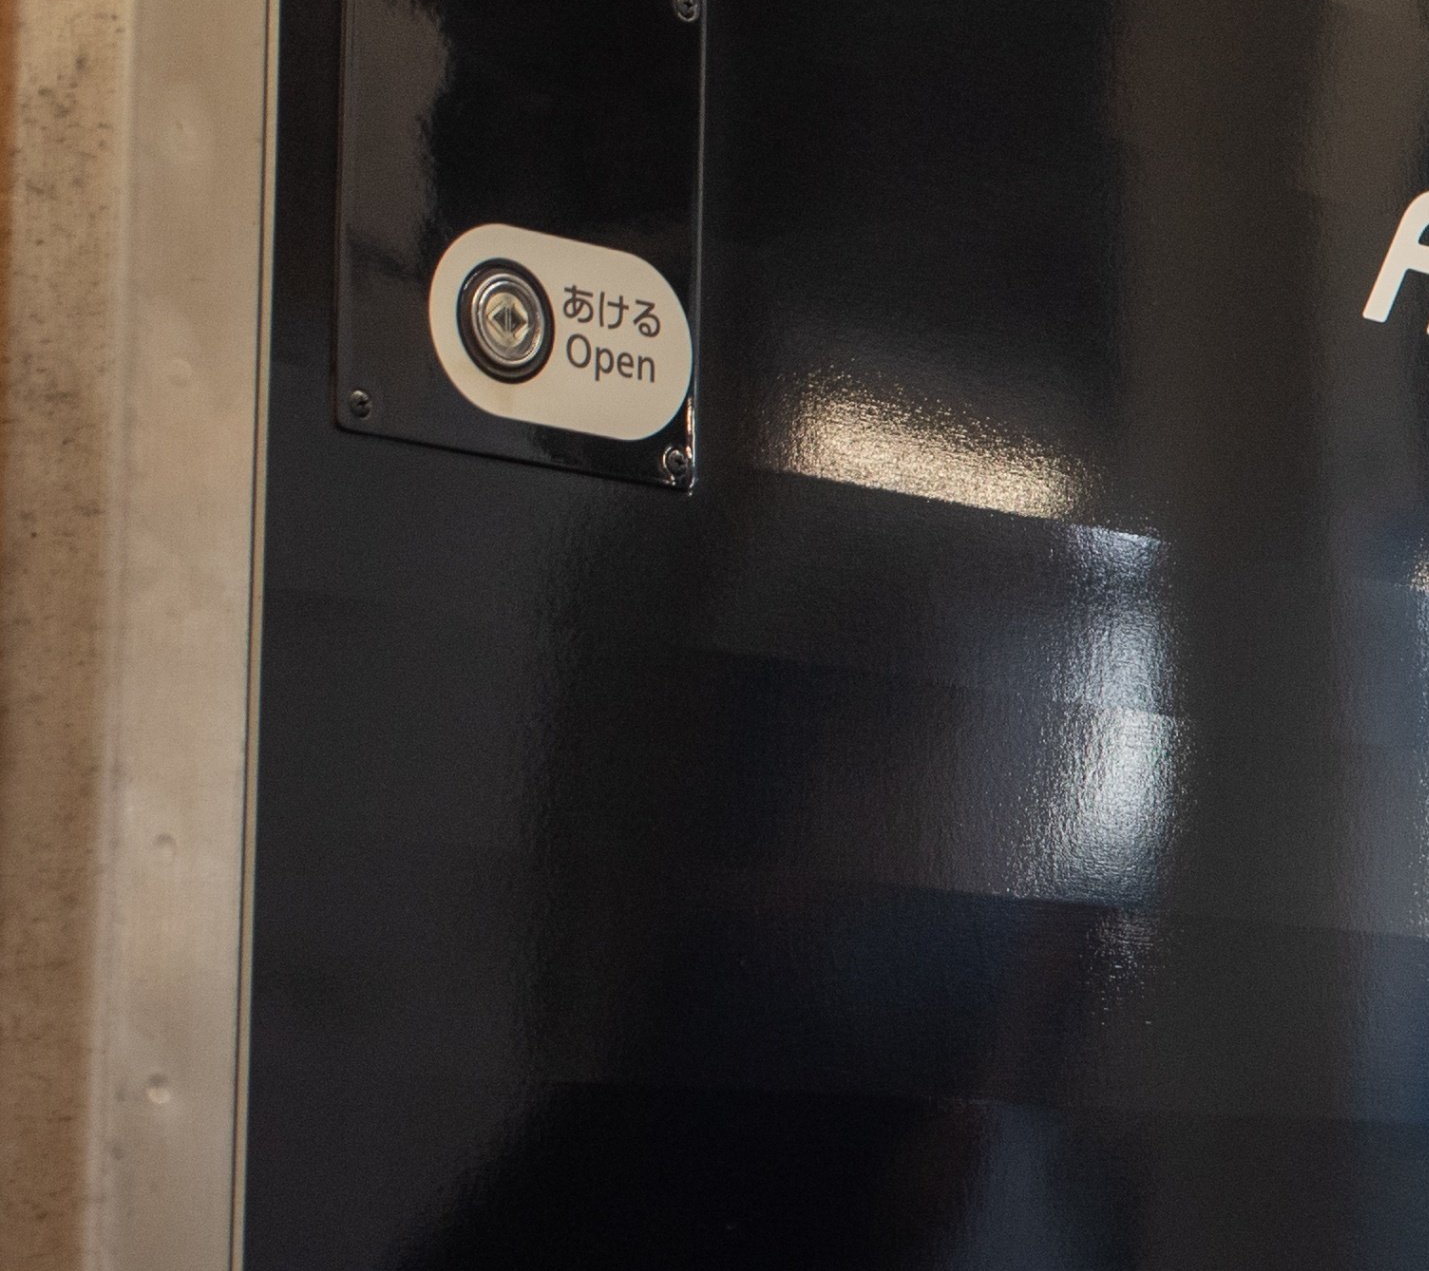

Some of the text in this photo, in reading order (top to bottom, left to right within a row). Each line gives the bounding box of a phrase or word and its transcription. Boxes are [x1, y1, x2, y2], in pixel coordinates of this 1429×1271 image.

[562, 284, 661, 338] あける
[565, 334, 656, 383] Open
